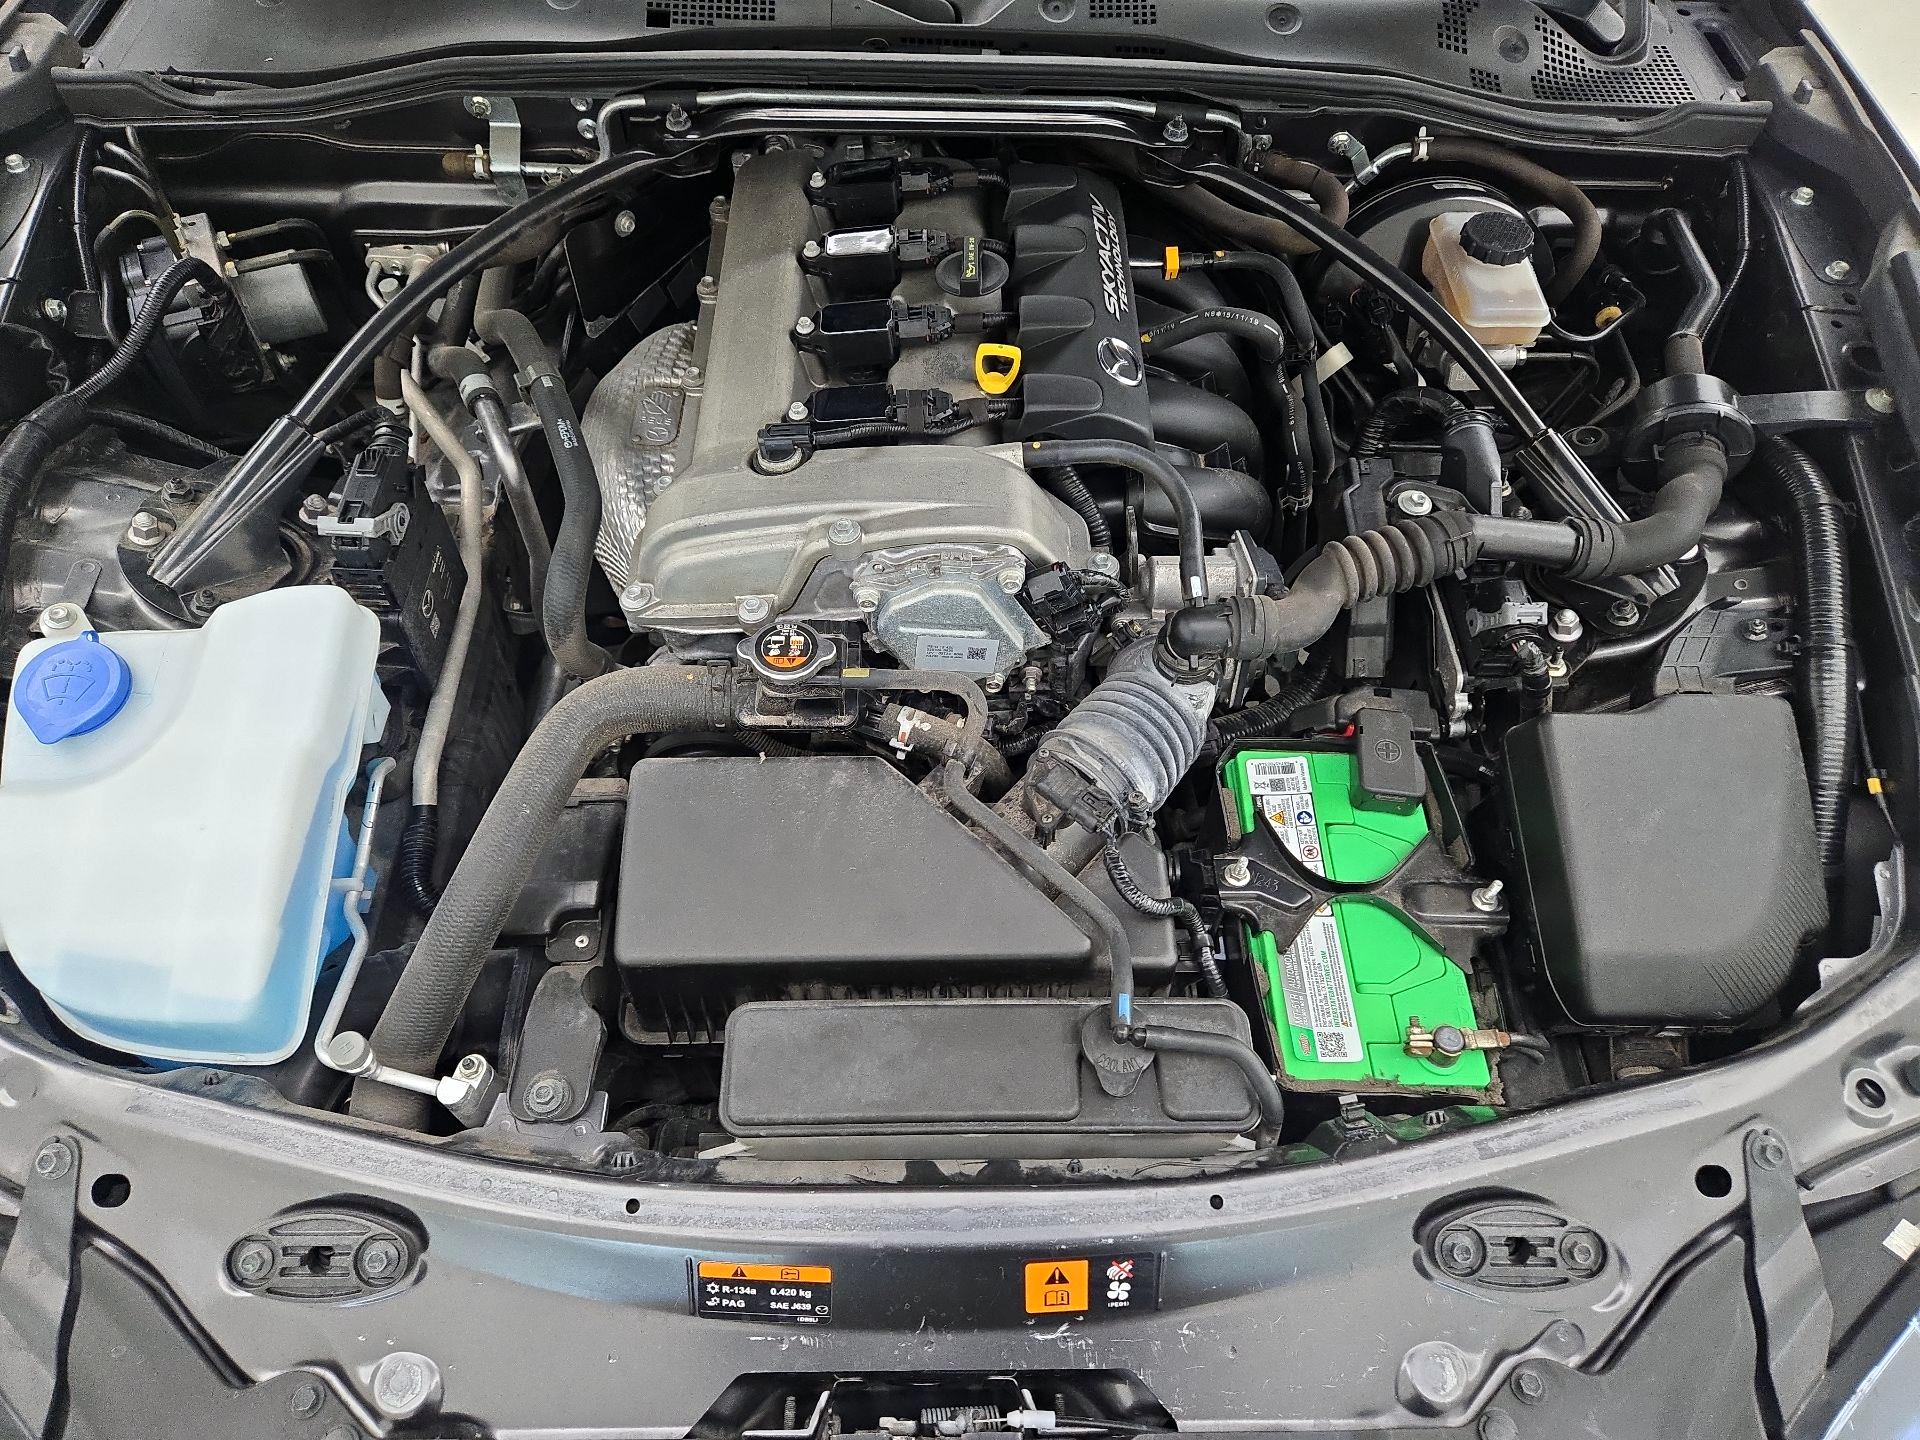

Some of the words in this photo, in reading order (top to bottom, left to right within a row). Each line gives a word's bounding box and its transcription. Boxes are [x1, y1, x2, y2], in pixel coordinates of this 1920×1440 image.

[1089, 192, 1121, 322] SKYACTIV
[1105, 208, 1129, 313] TECHNOLOGY
[1097, 1053, 1143, 1074] COOLANT
[721, 1285, 757, 1296] R-134a
[769, 1287, 797, 1297] 0.420
[798, 1289, 812, 1299] kg
[721, 1299, 746, 1308] PAG
[769, 1302, 790, 1310] SAE
[790, 1303, 812, 1311] J639
